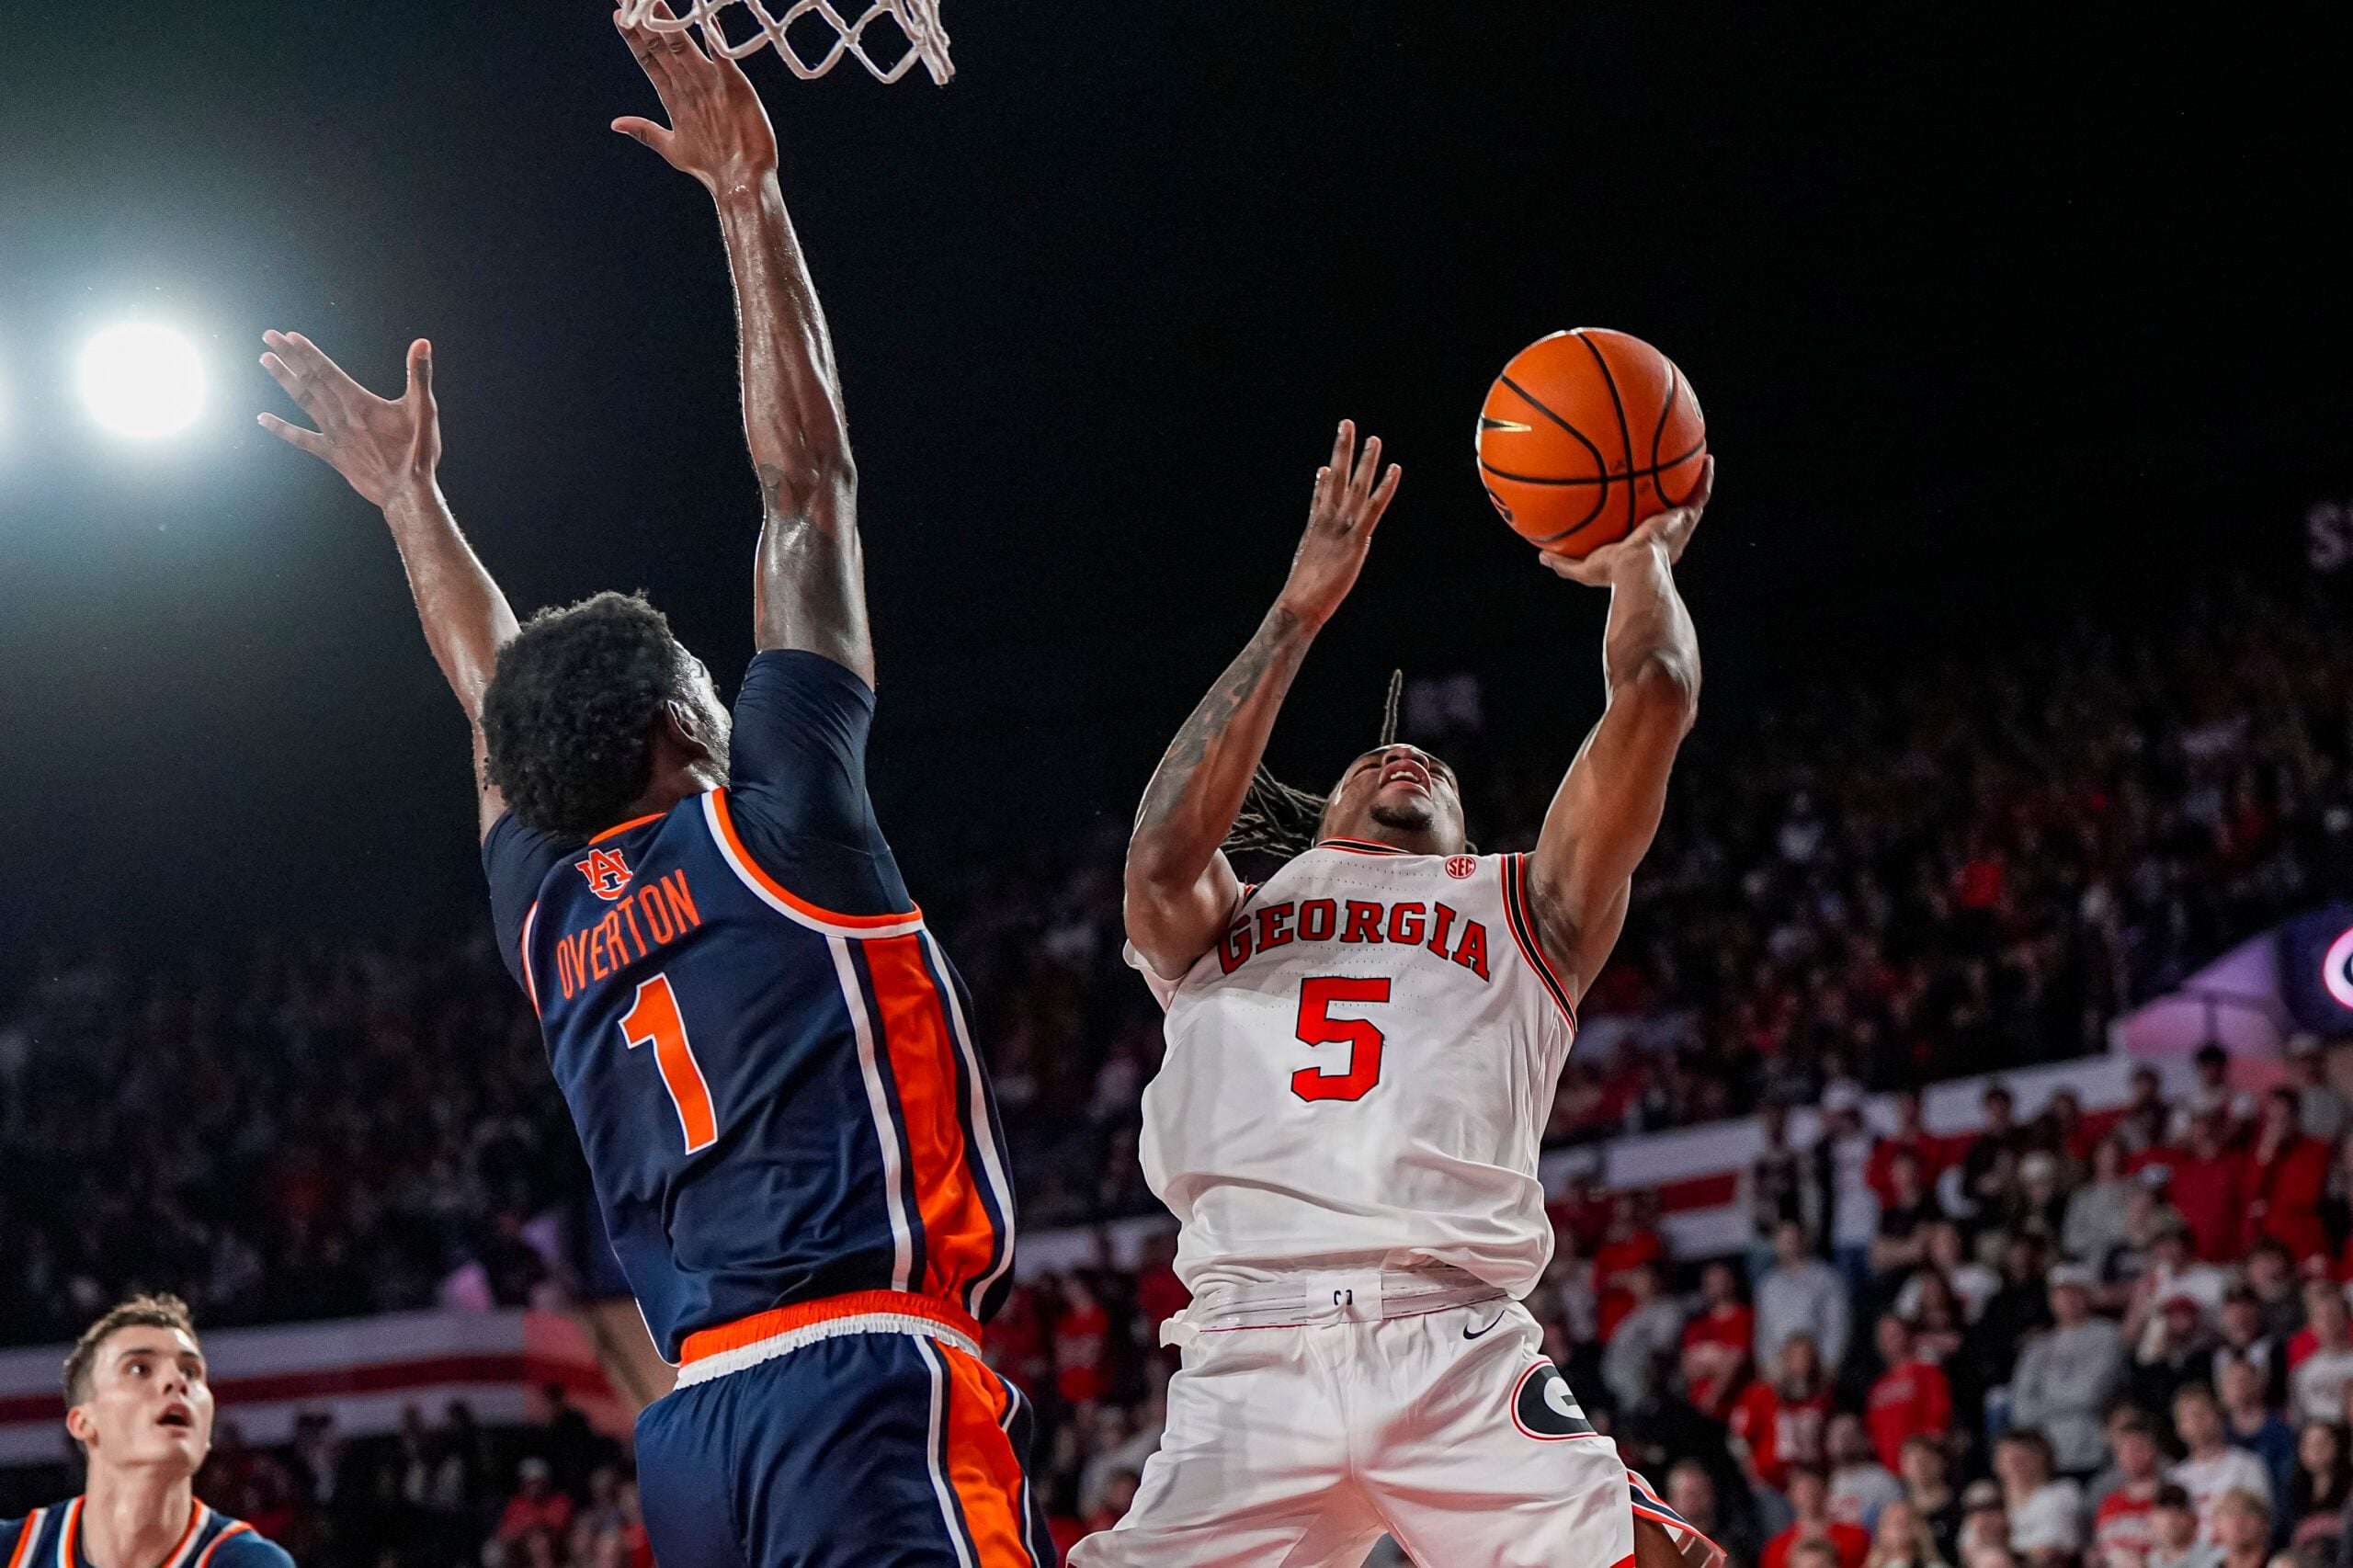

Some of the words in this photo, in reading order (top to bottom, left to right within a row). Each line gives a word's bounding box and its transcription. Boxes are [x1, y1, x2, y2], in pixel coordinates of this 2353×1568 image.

[1447, 856, 1474, 877] SEC
[556, 869, 701, 1000] OVERTON
[1217, 898, 1490, 983] GEORGIA
[618, 971, 719, 1156] 1
[1291, 976, 1392, 1102] 5
